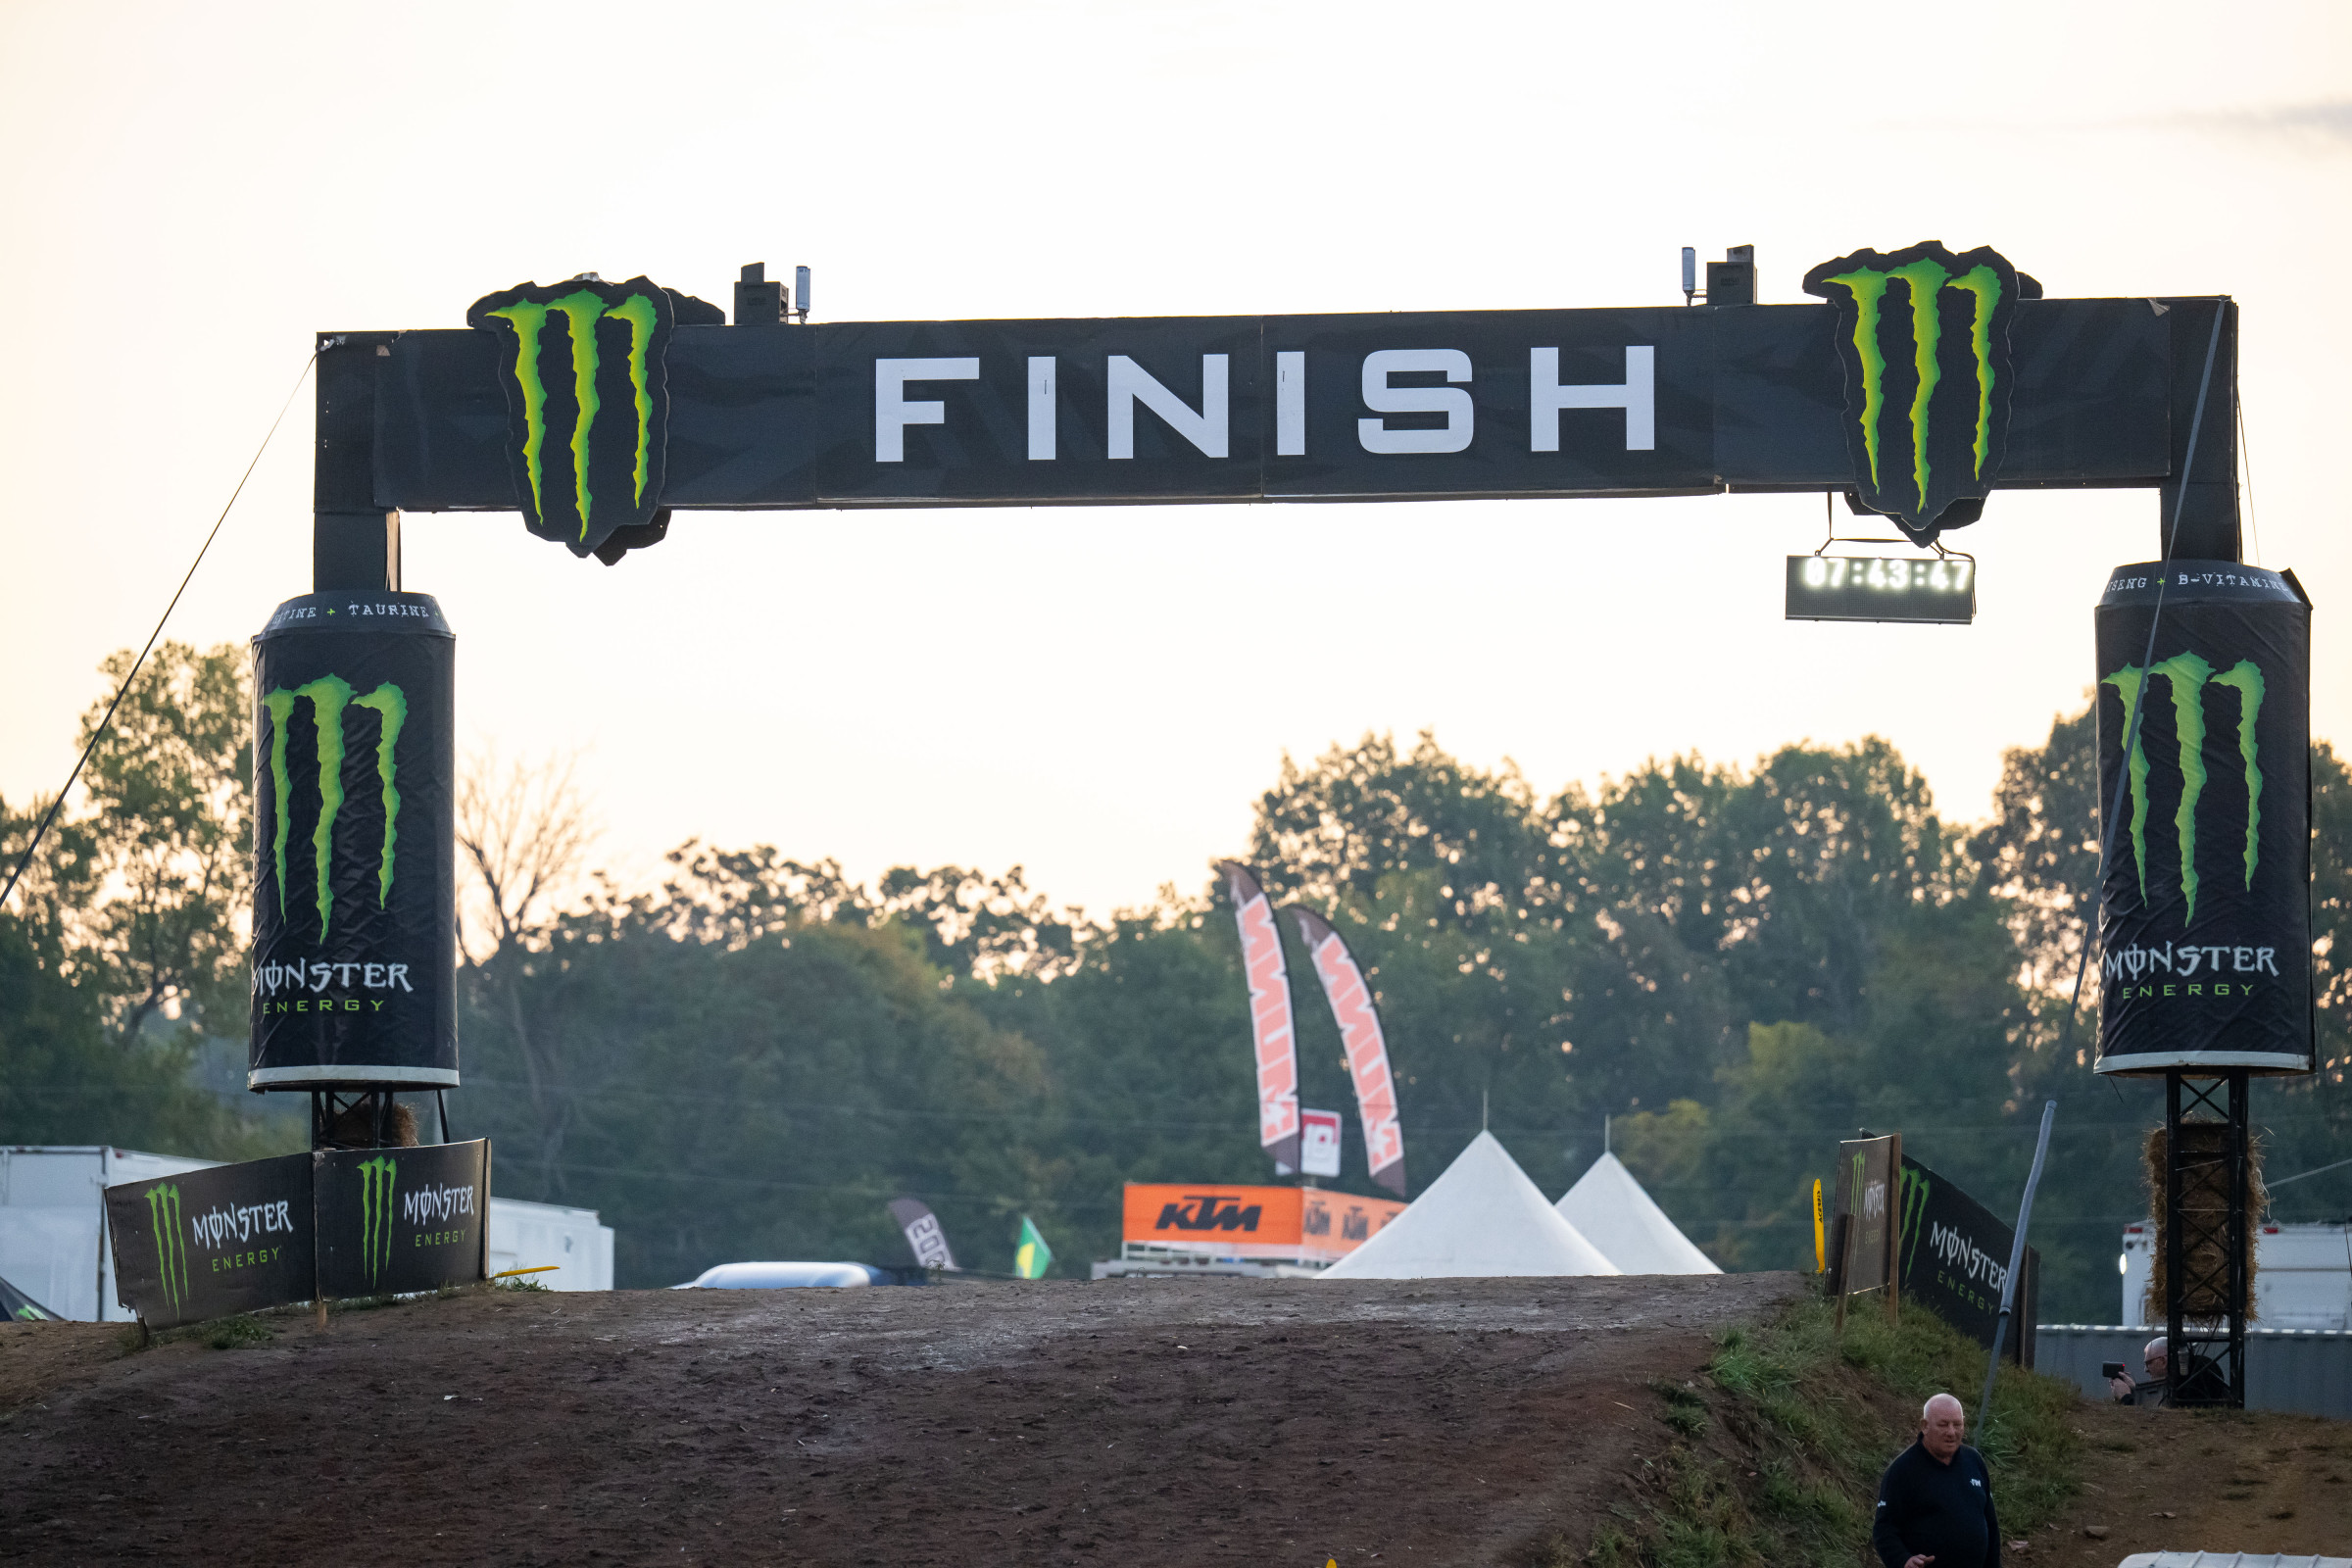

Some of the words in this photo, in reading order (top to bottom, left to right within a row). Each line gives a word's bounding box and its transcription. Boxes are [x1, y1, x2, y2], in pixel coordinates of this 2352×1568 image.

[875, 345, 1655, 463] FINISH
[348, 601, 430, 618] TAURINE
[2123, 983, 2254, 1000] ENERGY
[263, 999, 385, 1014] ENERGY
[1154, 1195, 1263, 1232] KTM
[416, 1229, 466, 1248] ENERGY
[212, 1247, 281, 1272] ENERGY
[1937, 1270, 1995, 1315] ENERGY
